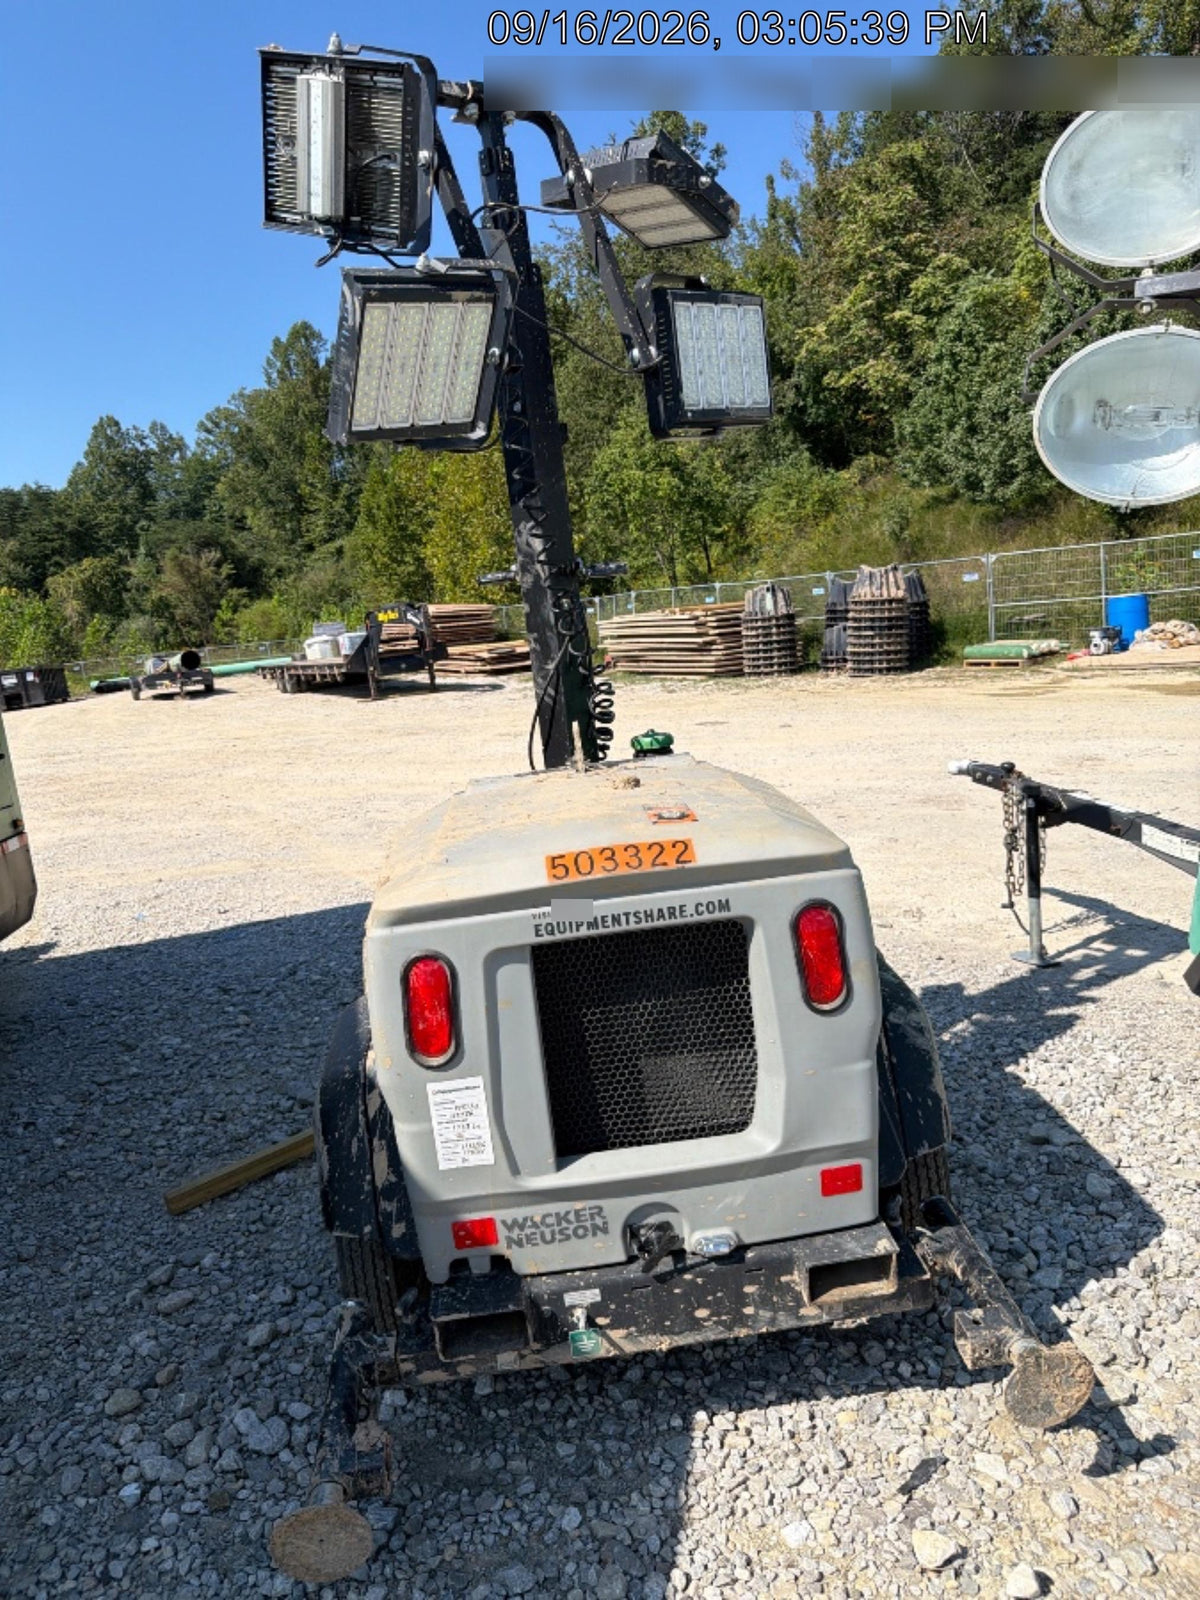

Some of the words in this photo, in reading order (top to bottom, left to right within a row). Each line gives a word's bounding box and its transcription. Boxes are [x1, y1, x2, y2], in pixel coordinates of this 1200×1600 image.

[550, 840, 693, 880] 503322
[534, 898, 731, 937] EQUIPMENTSHARE.COM
[501, 1205, 606, 1233] WACKER
[505, 1221, 609, 1249] NEUSON
